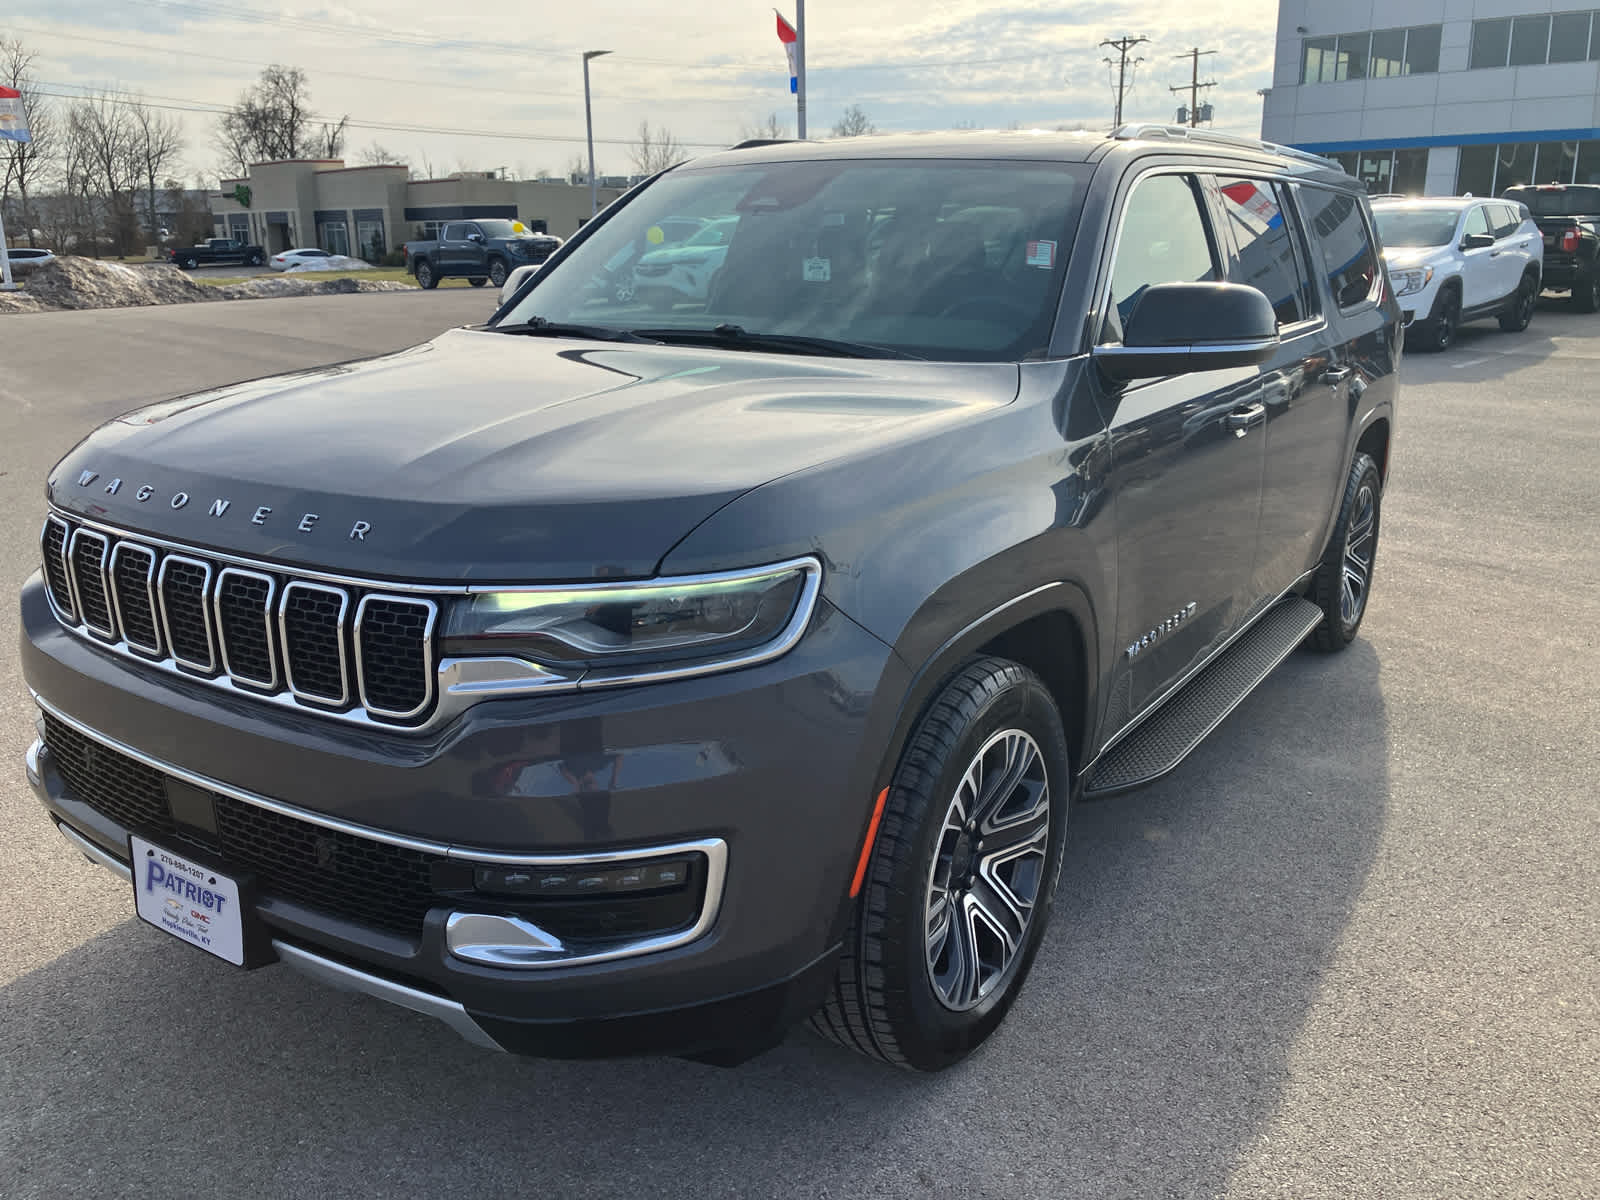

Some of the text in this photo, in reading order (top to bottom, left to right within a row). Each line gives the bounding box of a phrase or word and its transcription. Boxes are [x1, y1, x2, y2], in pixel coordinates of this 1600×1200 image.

[78, 470, 371, 541] WAGONEER
[146, 860, 225, 913] PATRIOT
[190, 910, 211, 924] GMC
[201, 935, 211, 946] KY
